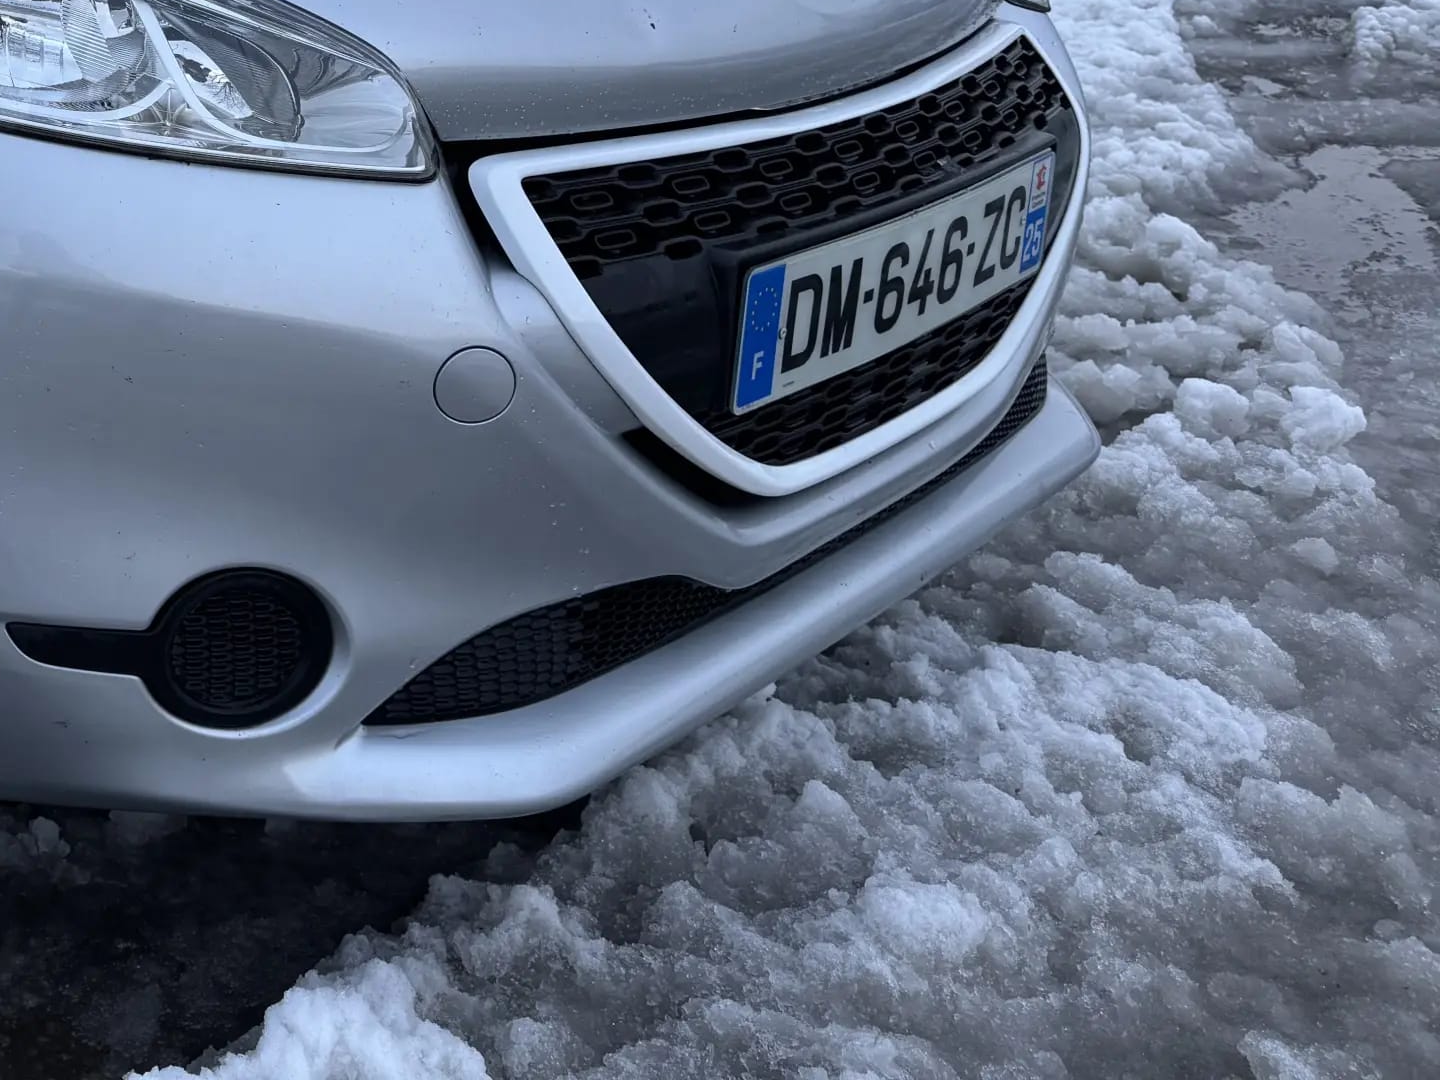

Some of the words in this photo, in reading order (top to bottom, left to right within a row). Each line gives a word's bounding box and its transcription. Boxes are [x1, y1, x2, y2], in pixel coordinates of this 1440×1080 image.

[1023, 218, 1044, 263] 25
[780, 185, 1027, 374] DM-646-ZC
[751, 350, 765, 380] F
